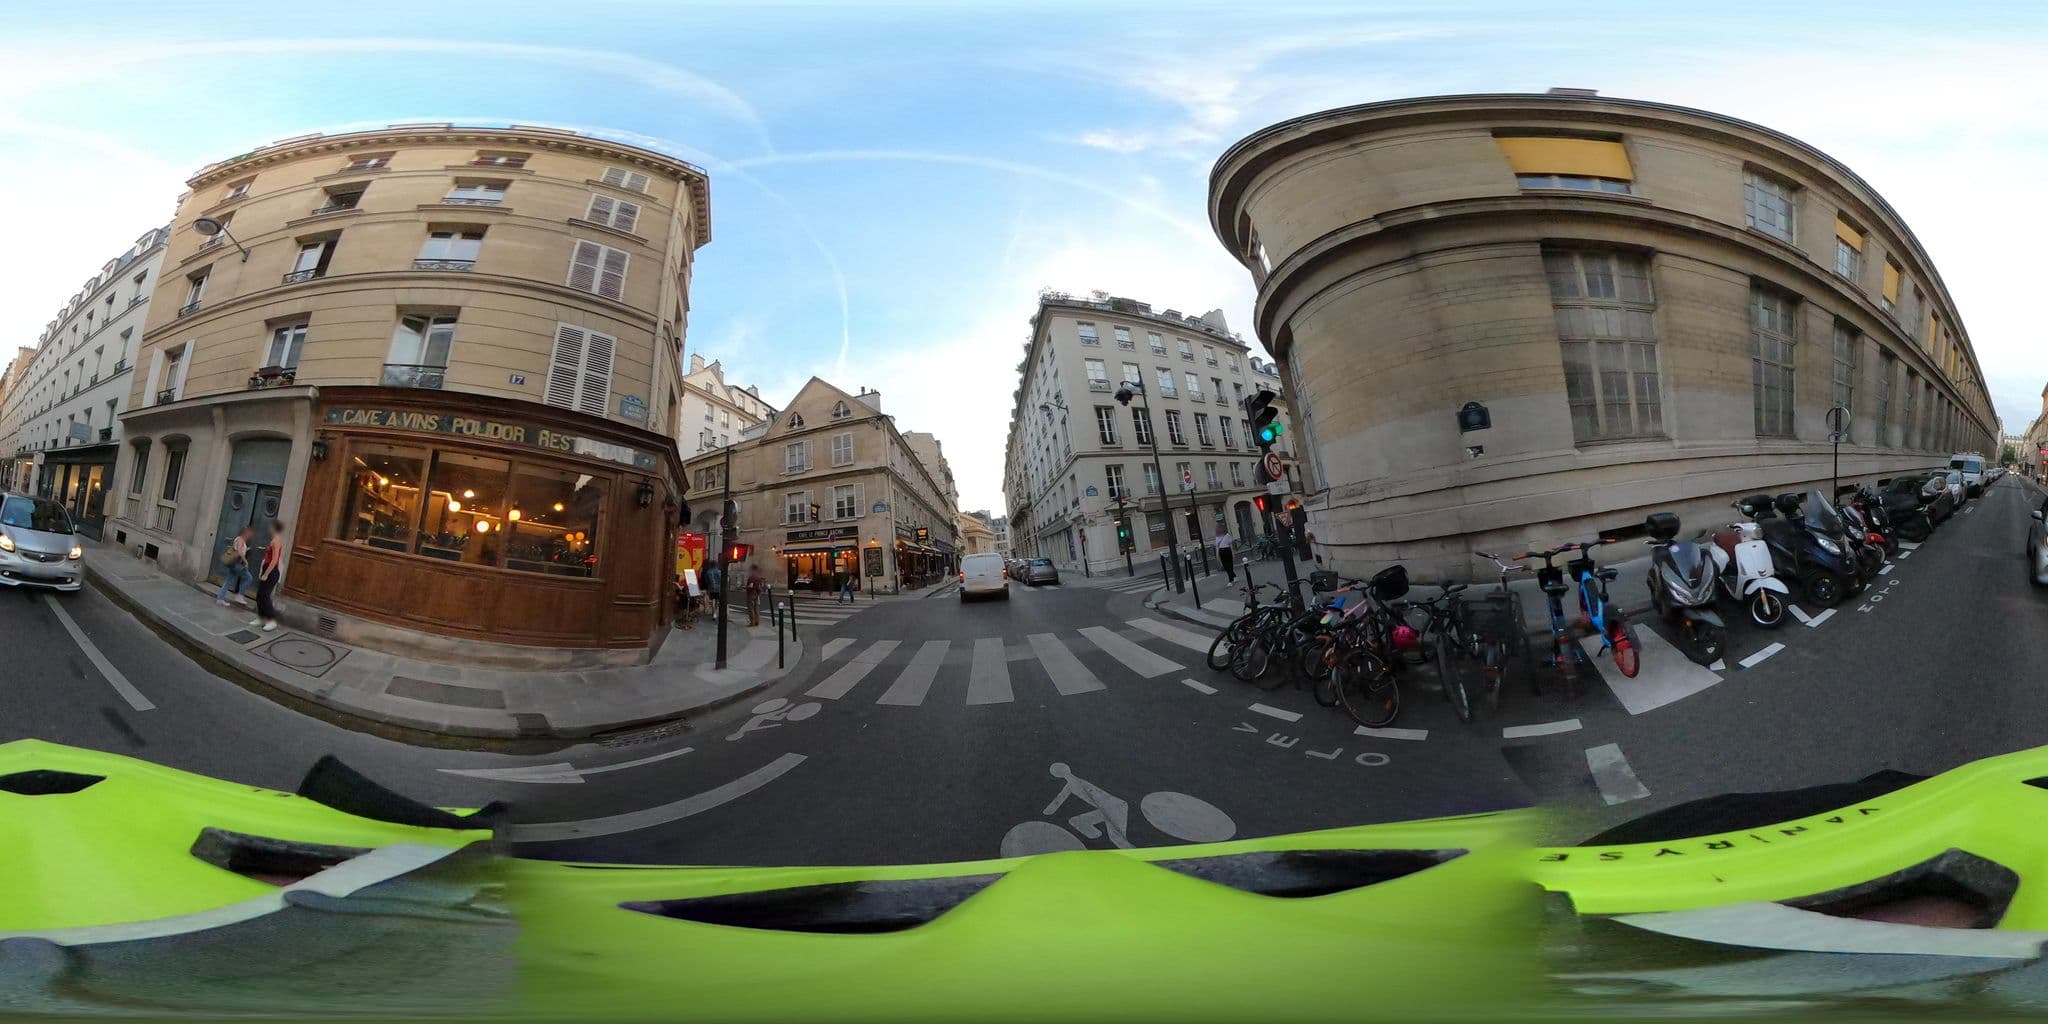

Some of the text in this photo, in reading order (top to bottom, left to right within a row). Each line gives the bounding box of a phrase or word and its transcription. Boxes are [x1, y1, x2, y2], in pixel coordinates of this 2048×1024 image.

[511, 375, 524, 384] 17
[342, 409, 382, 426] CAVE
[386, 411, 398, 427] A
[401, 412, 440, 431] VINS
[452, 417, 525, 443] POLIDOR
[1857, 580, 1900, 612] MOTO
[1232, 722, 1391, 766] VELO
